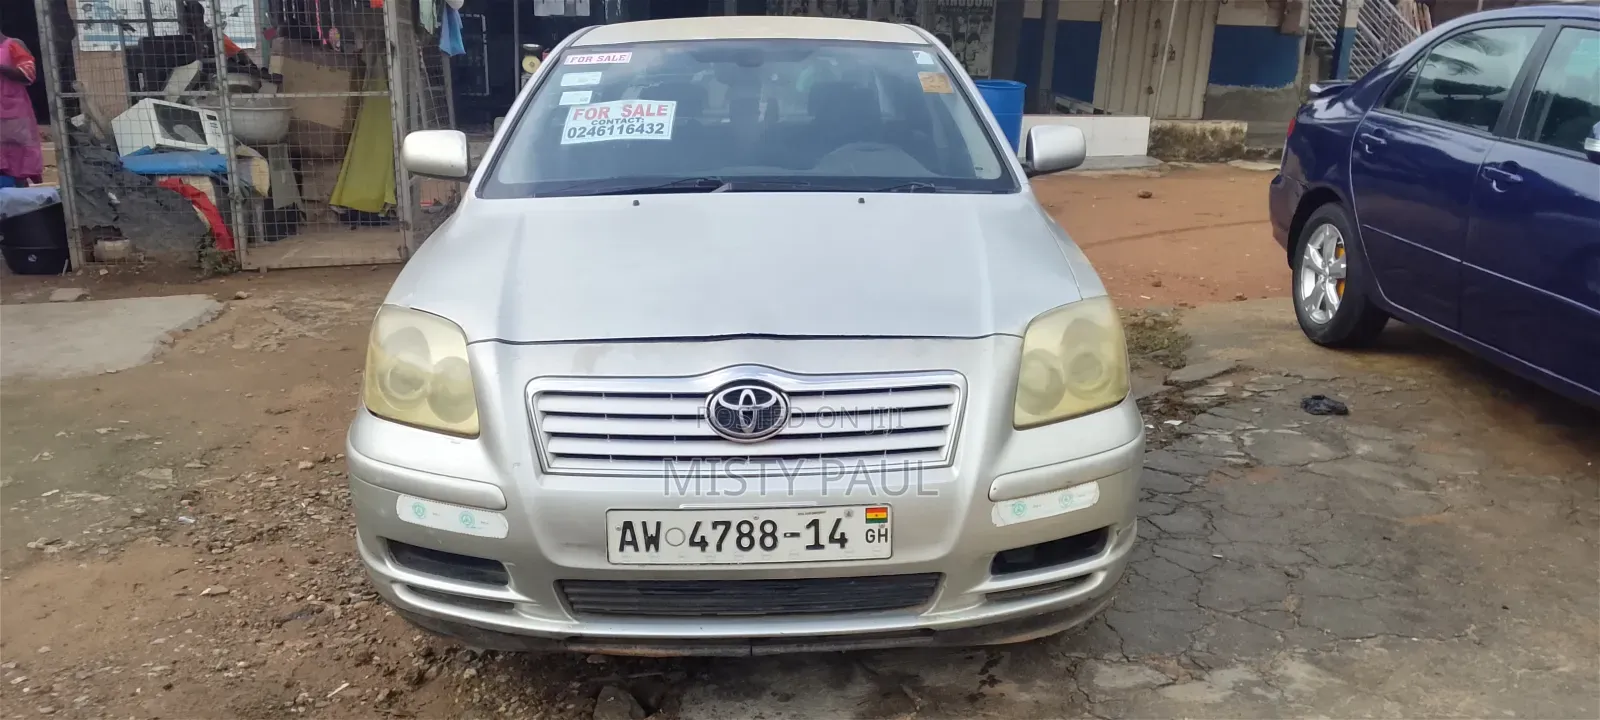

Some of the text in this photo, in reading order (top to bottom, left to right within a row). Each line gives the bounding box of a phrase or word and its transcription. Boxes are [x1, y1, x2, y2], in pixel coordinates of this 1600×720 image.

[597, 54, 626, 62] SALE
[573, 104, 669, 120] FOR SALE
[591, 117, 645, 125] CONTACT:
[567, 122, 665, 138] 0246116432
[619, 518, 848, 552] AW 4788-14
[865, 528, 888, 543] GH
